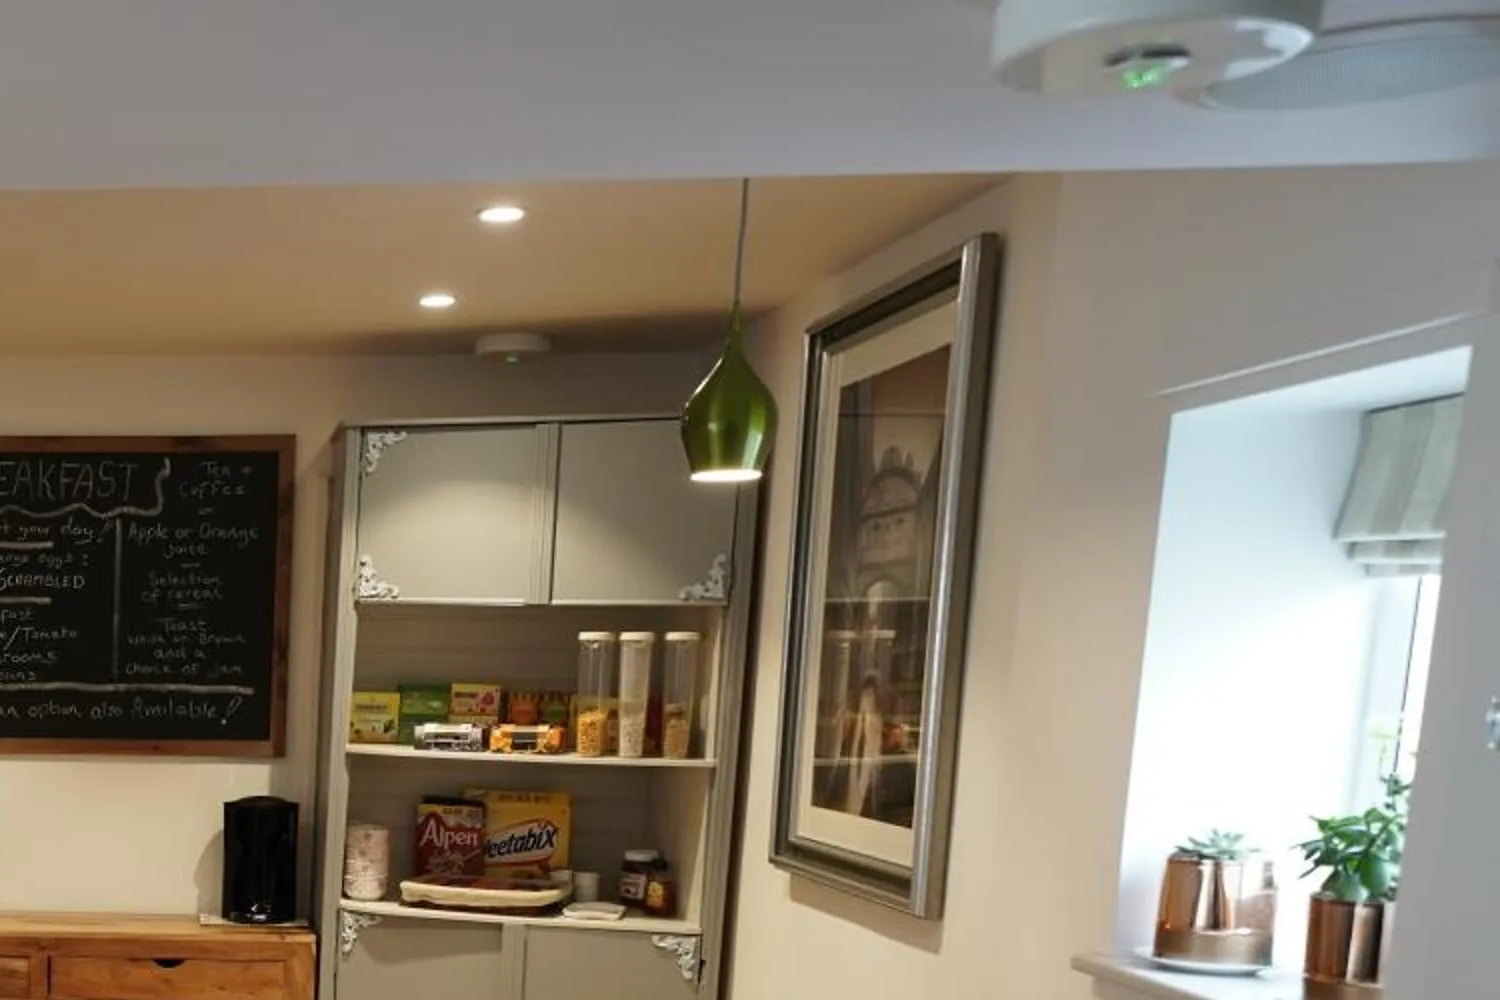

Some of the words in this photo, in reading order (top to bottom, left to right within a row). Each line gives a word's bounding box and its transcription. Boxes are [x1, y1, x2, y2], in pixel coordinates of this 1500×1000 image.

[128, 522, 169, 546] Apple
[174, 528, 195, 540] or
[198, 521, 259, 550] Orange
[26, 699, 84, 720] option
[90, 700, 124, 719] also
[419, 817, 479, 851] Alpen
